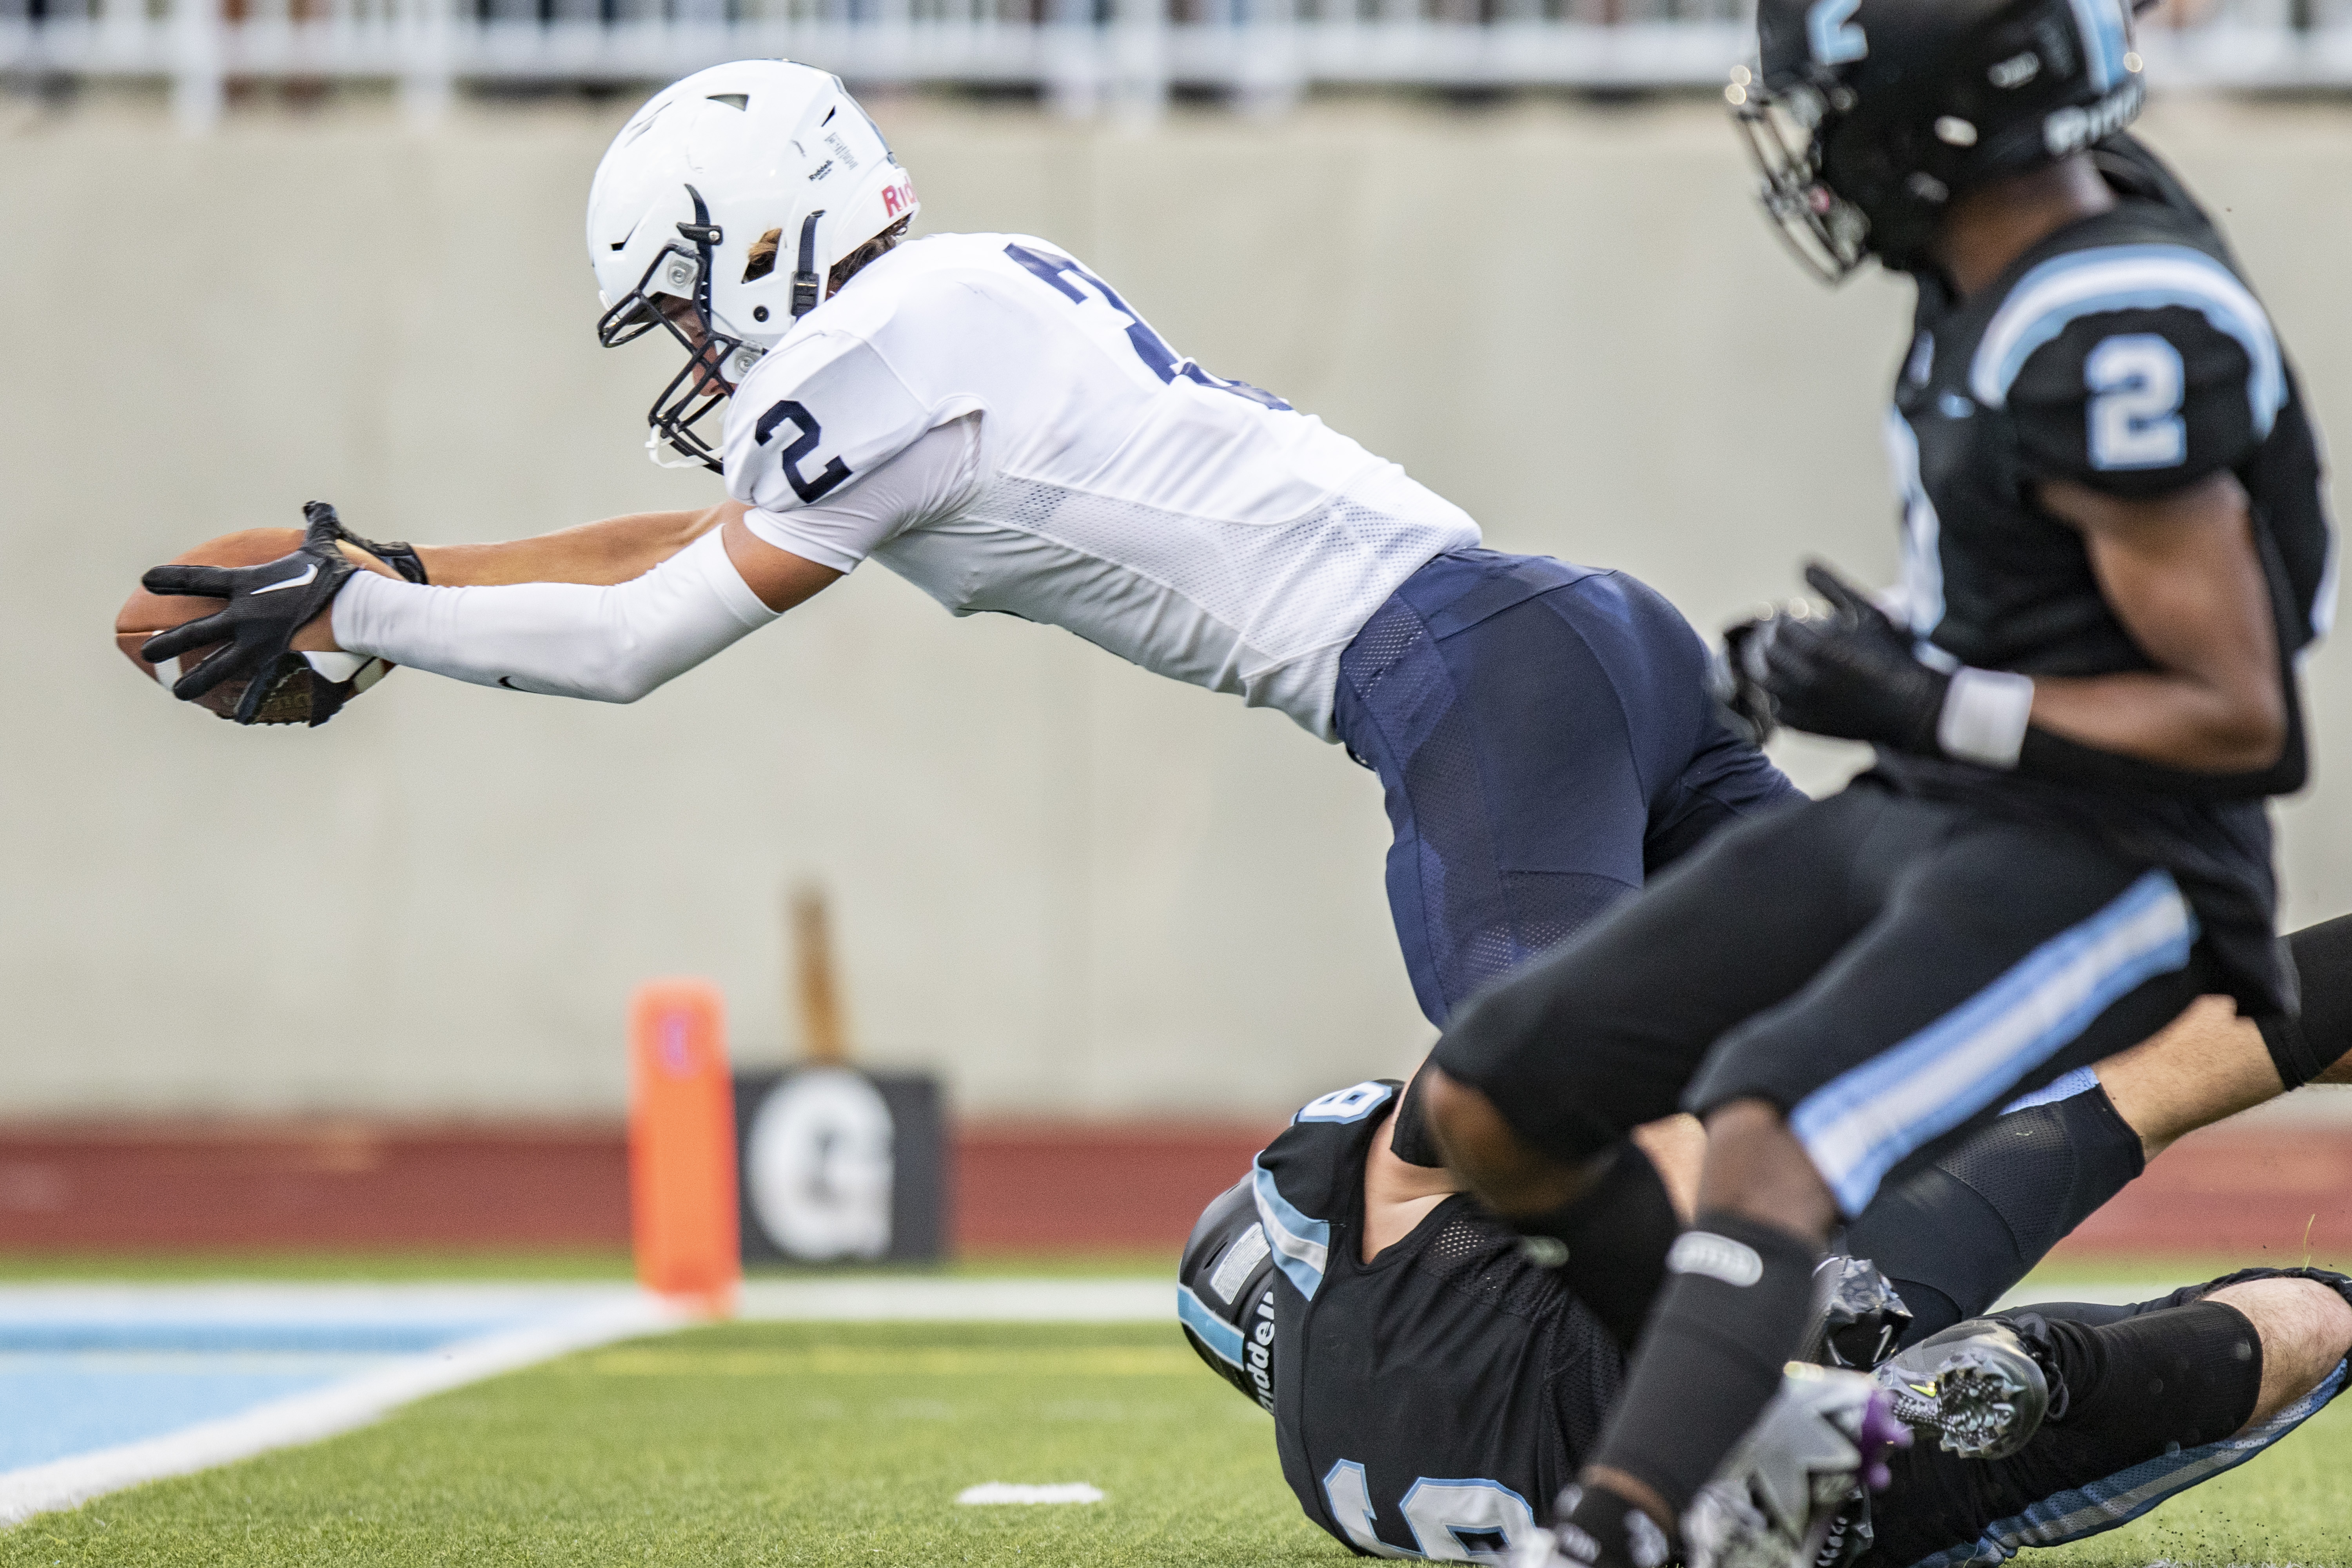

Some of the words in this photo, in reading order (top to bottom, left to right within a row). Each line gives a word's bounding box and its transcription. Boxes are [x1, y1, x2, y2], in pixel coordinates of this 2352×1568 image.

[754, 399, 853, 504] 2
[2083, 332, 2187, 470] 2
[748, 1067, 894, 1260] G
